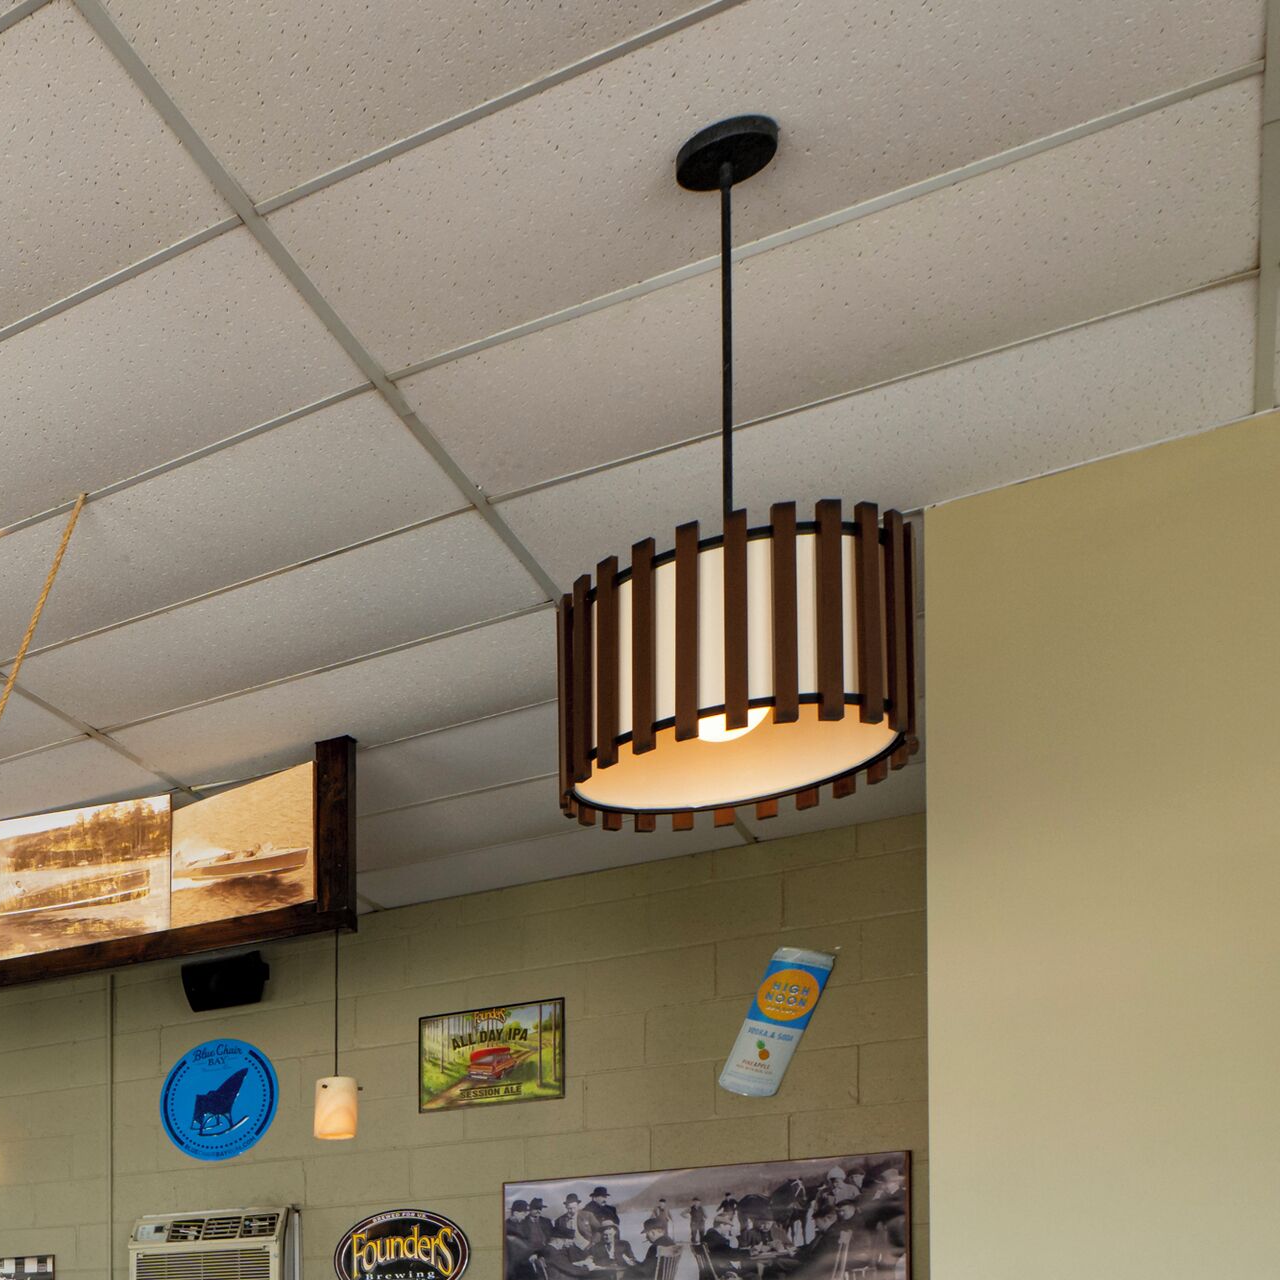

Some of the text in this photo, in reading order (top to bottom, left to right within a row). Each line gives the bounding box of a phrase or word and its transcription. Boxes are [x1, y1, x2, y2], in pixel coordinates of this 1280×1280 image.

[772, 981, 811, 998] HIGH
[765, 991, 808, 1008] NOON
[473, 1008, 506, 1024] Founders
[451, 1027, 529, 1051] ALL DAY IPA
[192, 1043, 243, 1063] Blue Chair
[207, 1057, 226, 1066] BAY
[460, 1085, 522, 1099] SESSION ALE
[351, 1224, 453, 1279] Founders
[365, 1270, 436, 1280] Brewing
